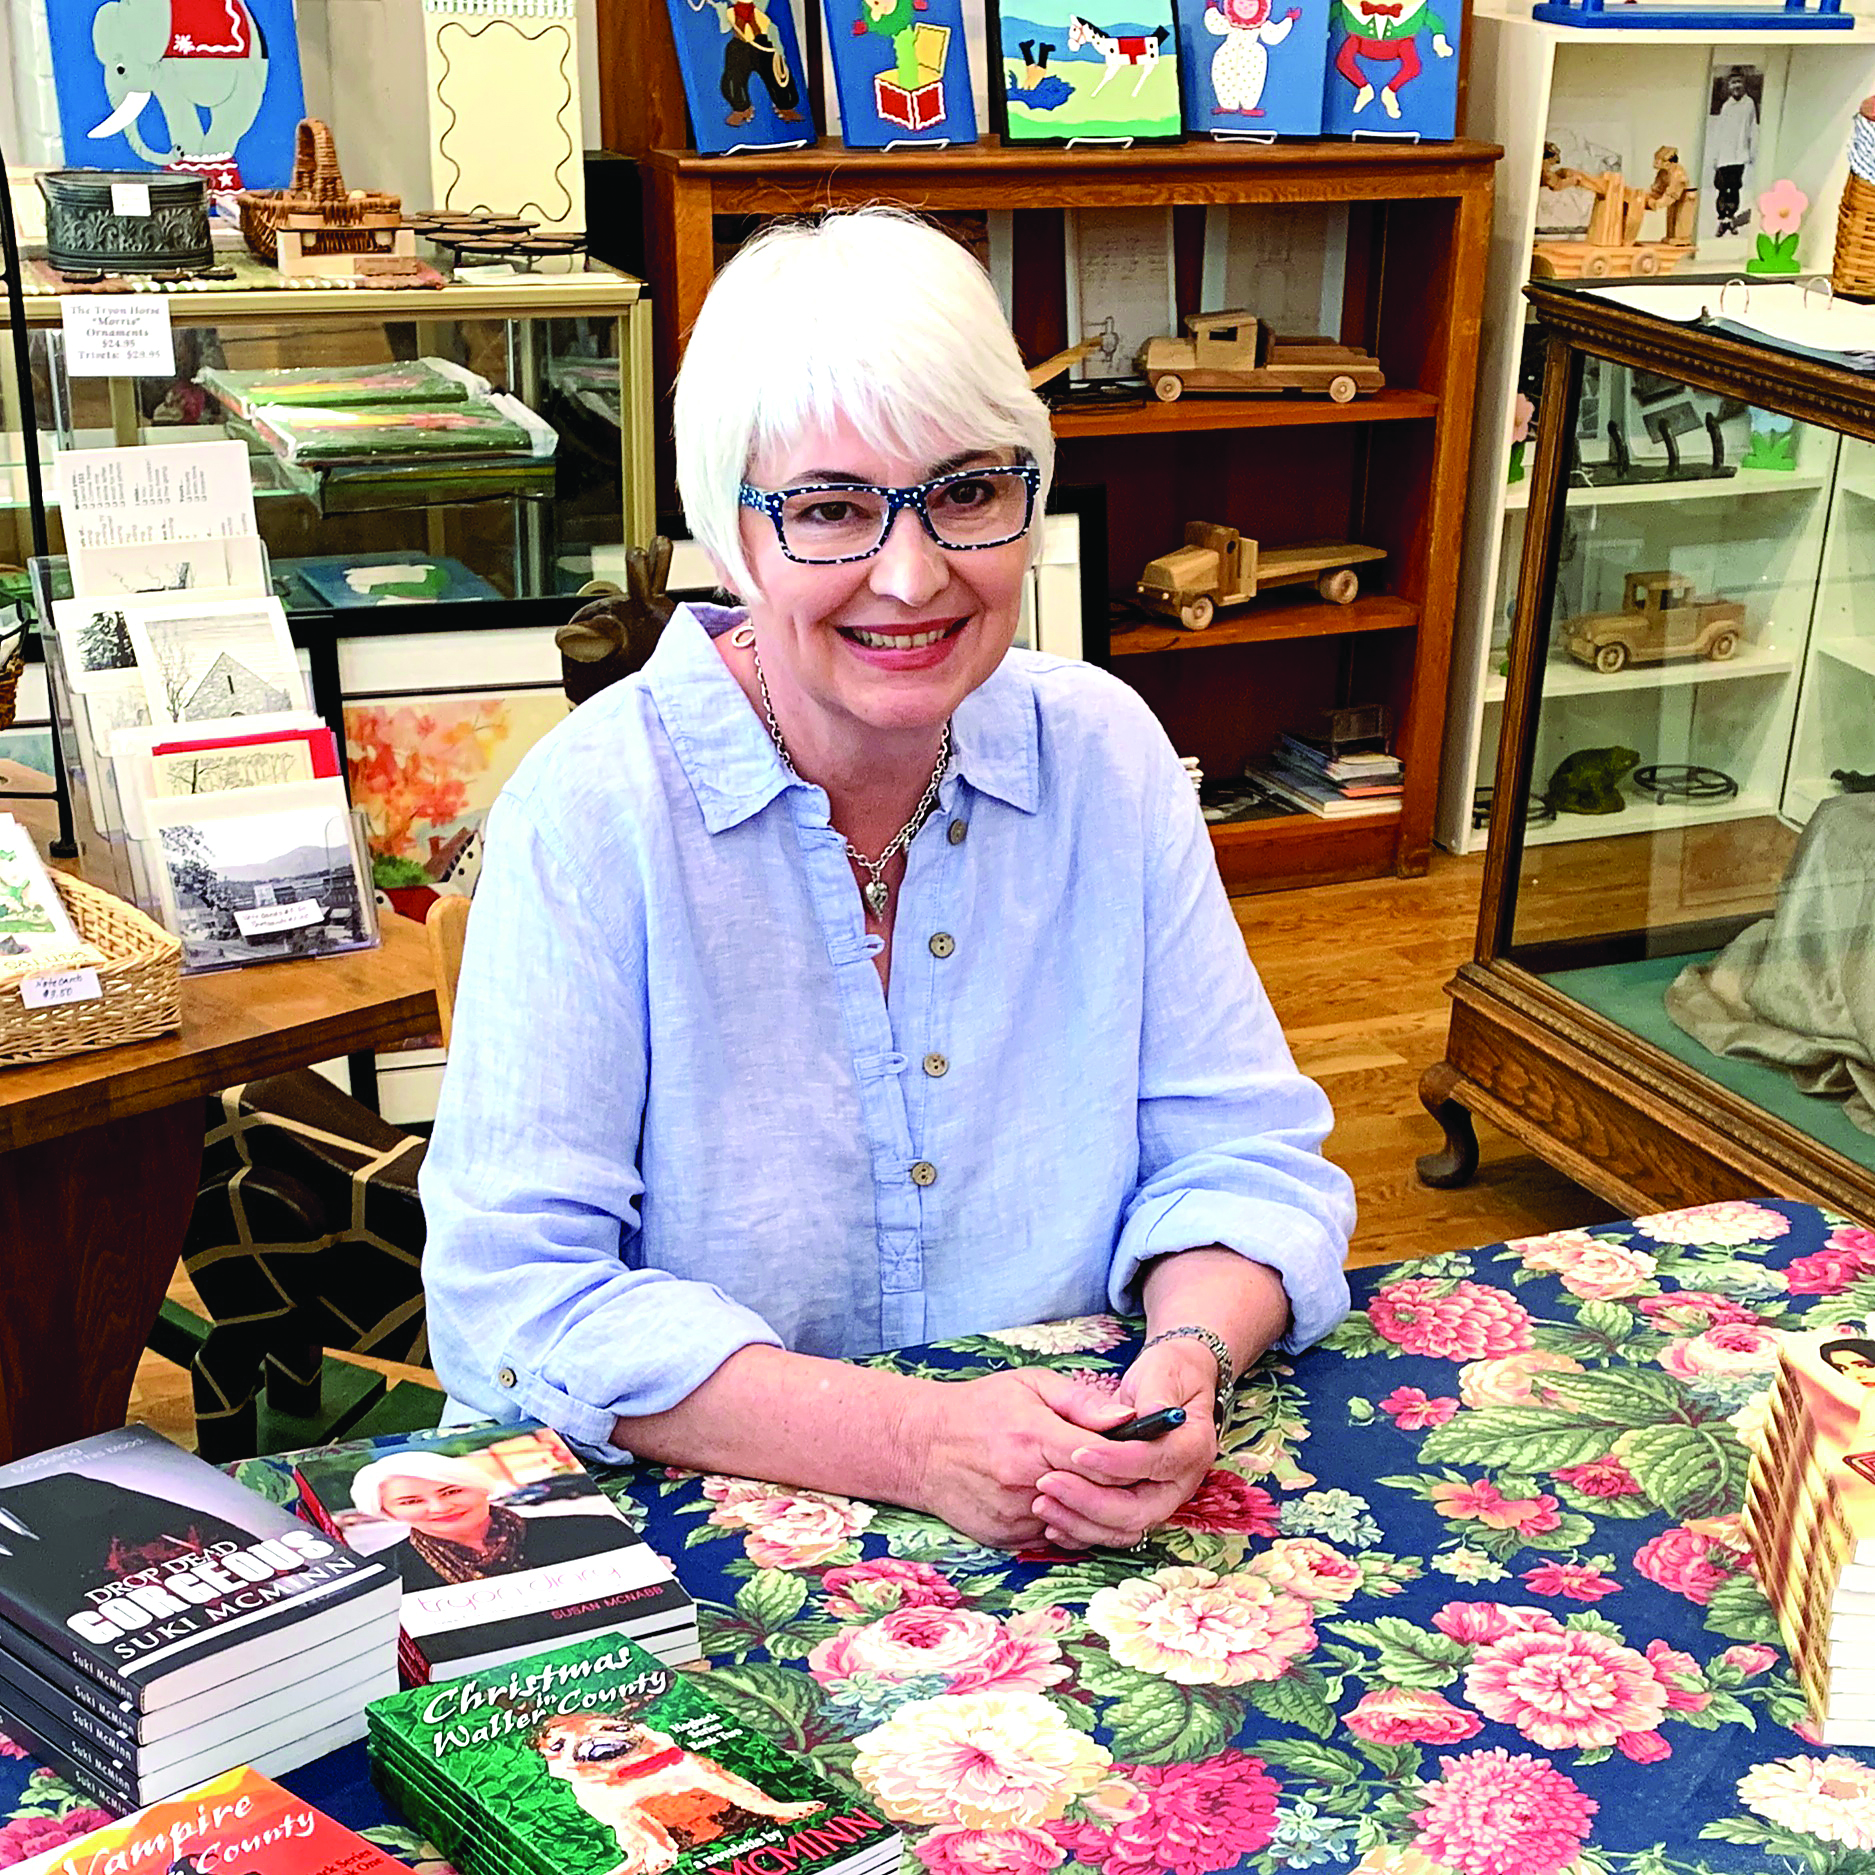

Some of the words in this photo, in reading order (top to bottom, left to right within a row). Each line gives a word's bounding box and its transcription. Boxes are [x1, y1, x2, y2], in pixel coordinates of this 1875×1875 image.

[70, 306, 90, 314] The
[95, 306, 127, 315] Tryon
[130, 306, 160, 314] Horse
[86, 328, 149, 336] Ornaments
[102, 339, 136, 348] $24.95
[66, 1530, 334, 1645] GORGEOUS
[84, 1567, 161, 1606] DROP
[161, 1541, 239, 1575] DEAD
[418, 1585, 523, 1613] tryon
[529, 1566, 622, 1592] diary
[113, 1617, 200, 1660] SUKI
[205, 1557, 356, 1622] MCMINN
[551, 1601, 601, 1621] SUSAN
[604, 1586, 665, 1608] MCNABB
[72, 1651, 94, 1673] Suki
[96, 1666, 134, 1701] McMinn
[422, 1646, 634, 1725] Christmas
[536, 1690, 560, 1708] in
[74, 1685, 96, 1708] Suki
[99, 1701, 135, 1736] McMinn
[433, 1704, 547, 1758] Waller
[557, 1672, 668, 1715] County
[72, 1710, 93, 1733] Suki
[96, 1726, 132, 1762] McMinn
[687, 1736, 721, 1751] Book
[716, 1728, 743, 1740] Two
[72, 1740, 92, 1763] Suki
[95, 1757, 131, 1792] McMinn
[75, 1770, 96, 1793] Suki
[99, 1788, 131, 1816] McMin
[63, 1795, 254, 1875] Vampire
[195, 1811, 314, 1874] County
[335, 1850, 372, 1868] Series
[693, 1860, 706, 1870] a
[705, 1837, 766, 1866] novelette
[760, 1830, 785, 1845] by
[356, 1858, 384, 1870] One
